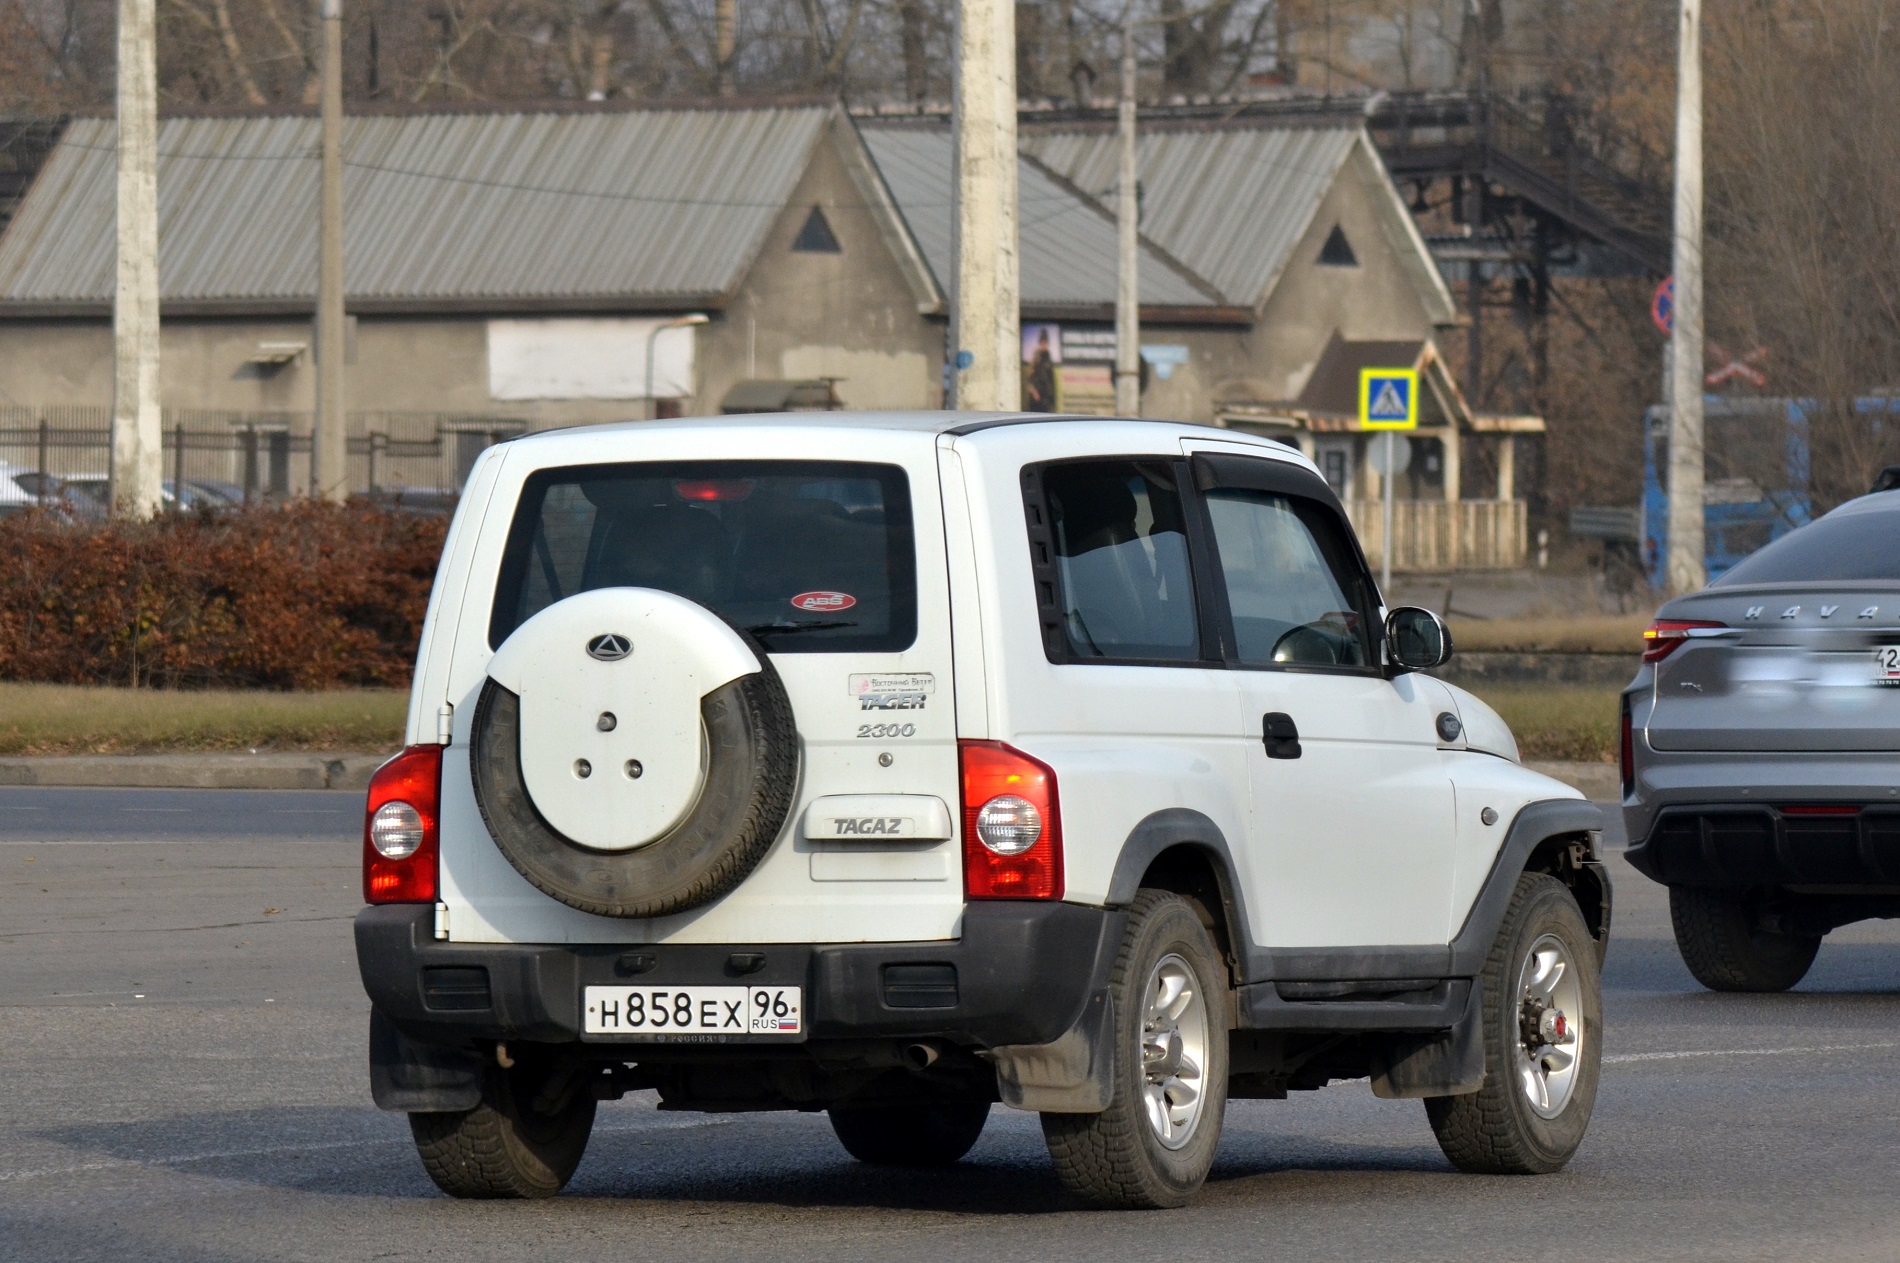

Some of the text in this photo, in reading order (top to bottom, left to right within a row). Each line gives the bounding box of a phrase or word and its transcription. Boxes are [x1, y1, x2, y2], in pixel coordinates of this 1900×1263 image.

[802, 593, 844, 608] ABS
[1744, 604, 1900, 620] HAVA
[859, 694, 927, 711] TAGER
[857, 722, 917, 738] 2300
[833, 818, 902, 835] TAGAZ
[754, 990, 789, 1018] 96
[752, 1018, 778, 1029] RUS
